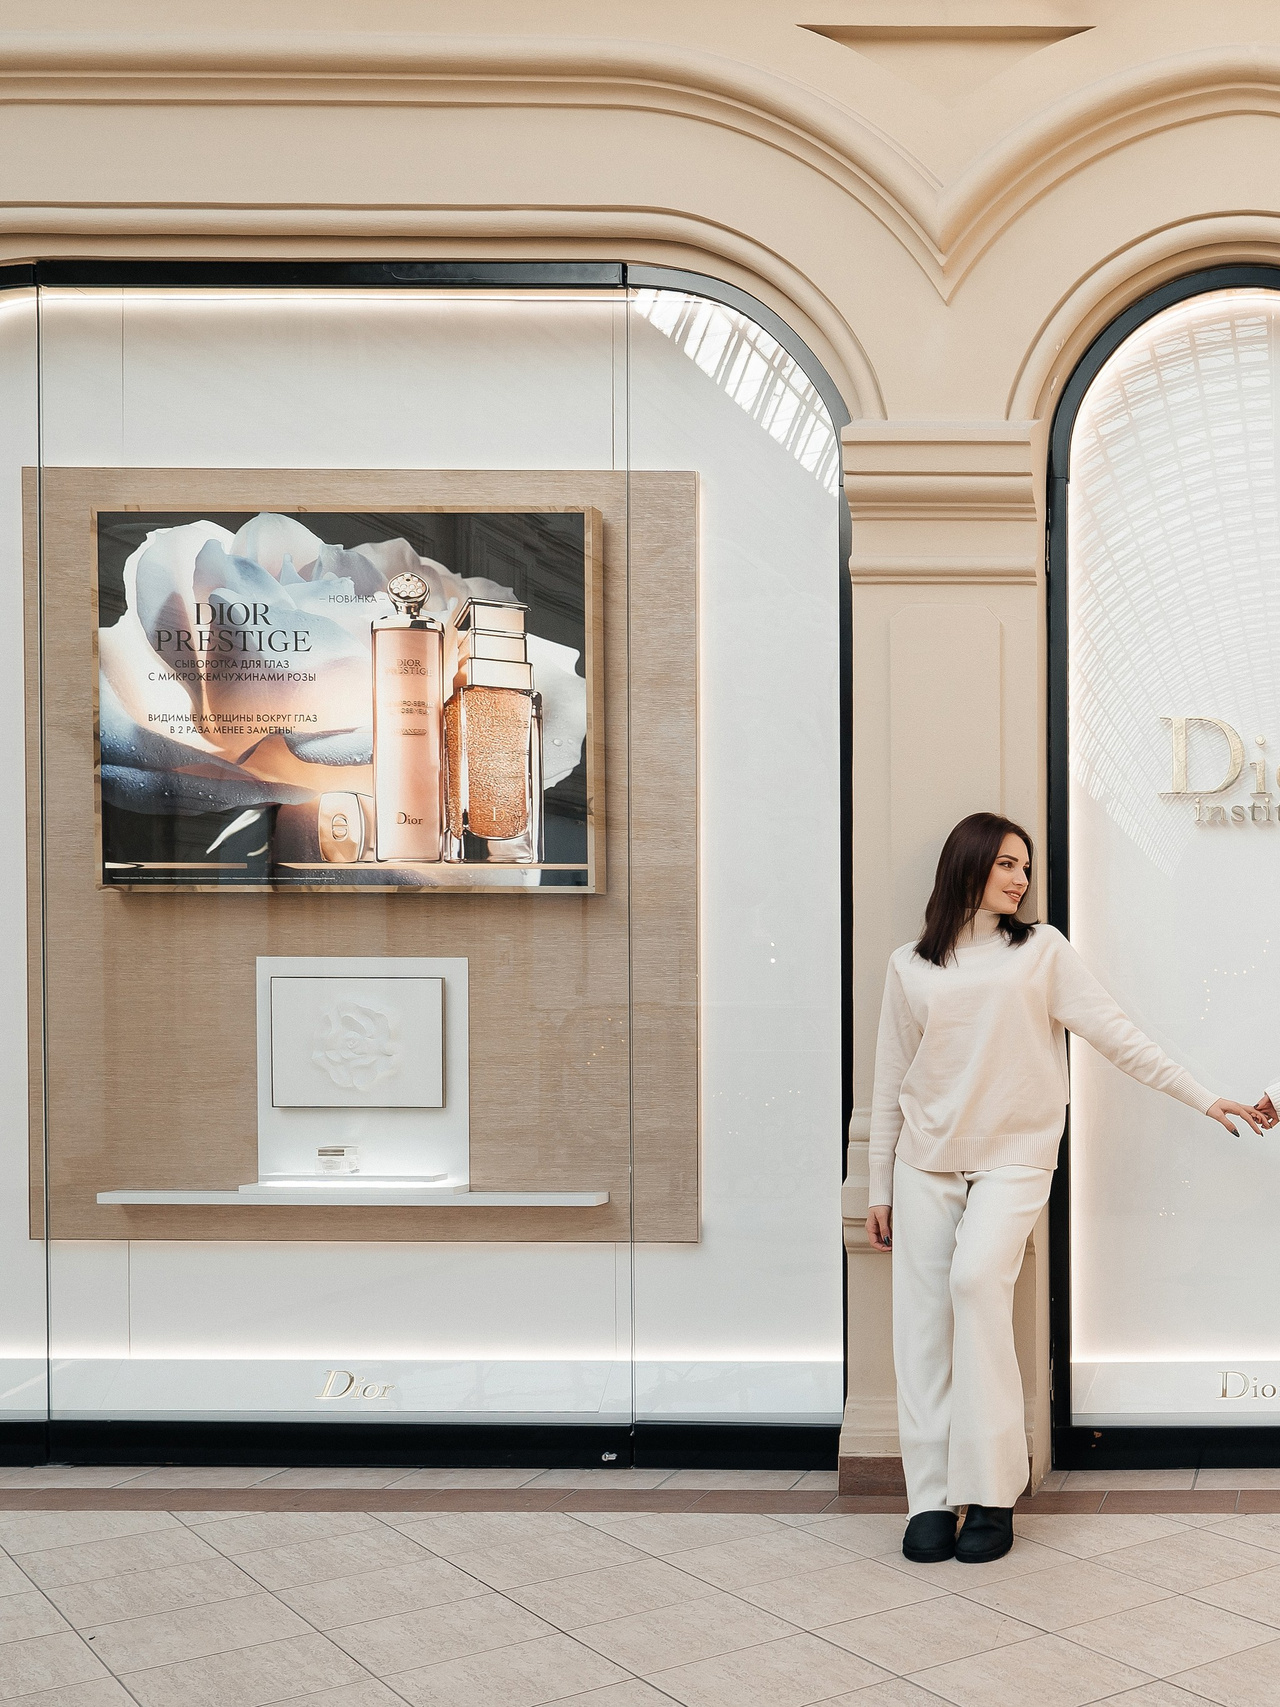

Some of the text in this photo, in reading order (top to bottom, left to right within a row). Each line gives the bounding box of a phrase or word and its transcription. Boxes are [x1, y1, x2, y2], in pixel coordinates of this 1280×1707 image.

[328, 595, 377, 603] НОВИНКА
[193, 602, 272, 626] DIOR
[155, 629, 313, 652] PRESTIGE
[174, 660, 290, 670] СЫВОРОТКА ДЛЯ ГЛАЗ
[148, 672, 317, 682] С МИКРОЖЕМЧУЖИНАМИ РОЗЫ
[148, 714, 318, 723] ВИДИМЫЕ МОРЩИНЫ ВОКРУГ ГЛАЗ
[170, 726, 176, 734] В
[178, 726, 183, 734] 2
[186, 726, 210, 734] РАЗА
[213, 726, 244, 734] МЕНЕЕ
[396, 811, 424, 825] Dior
[314, 1369, 396, 1400] Dior
